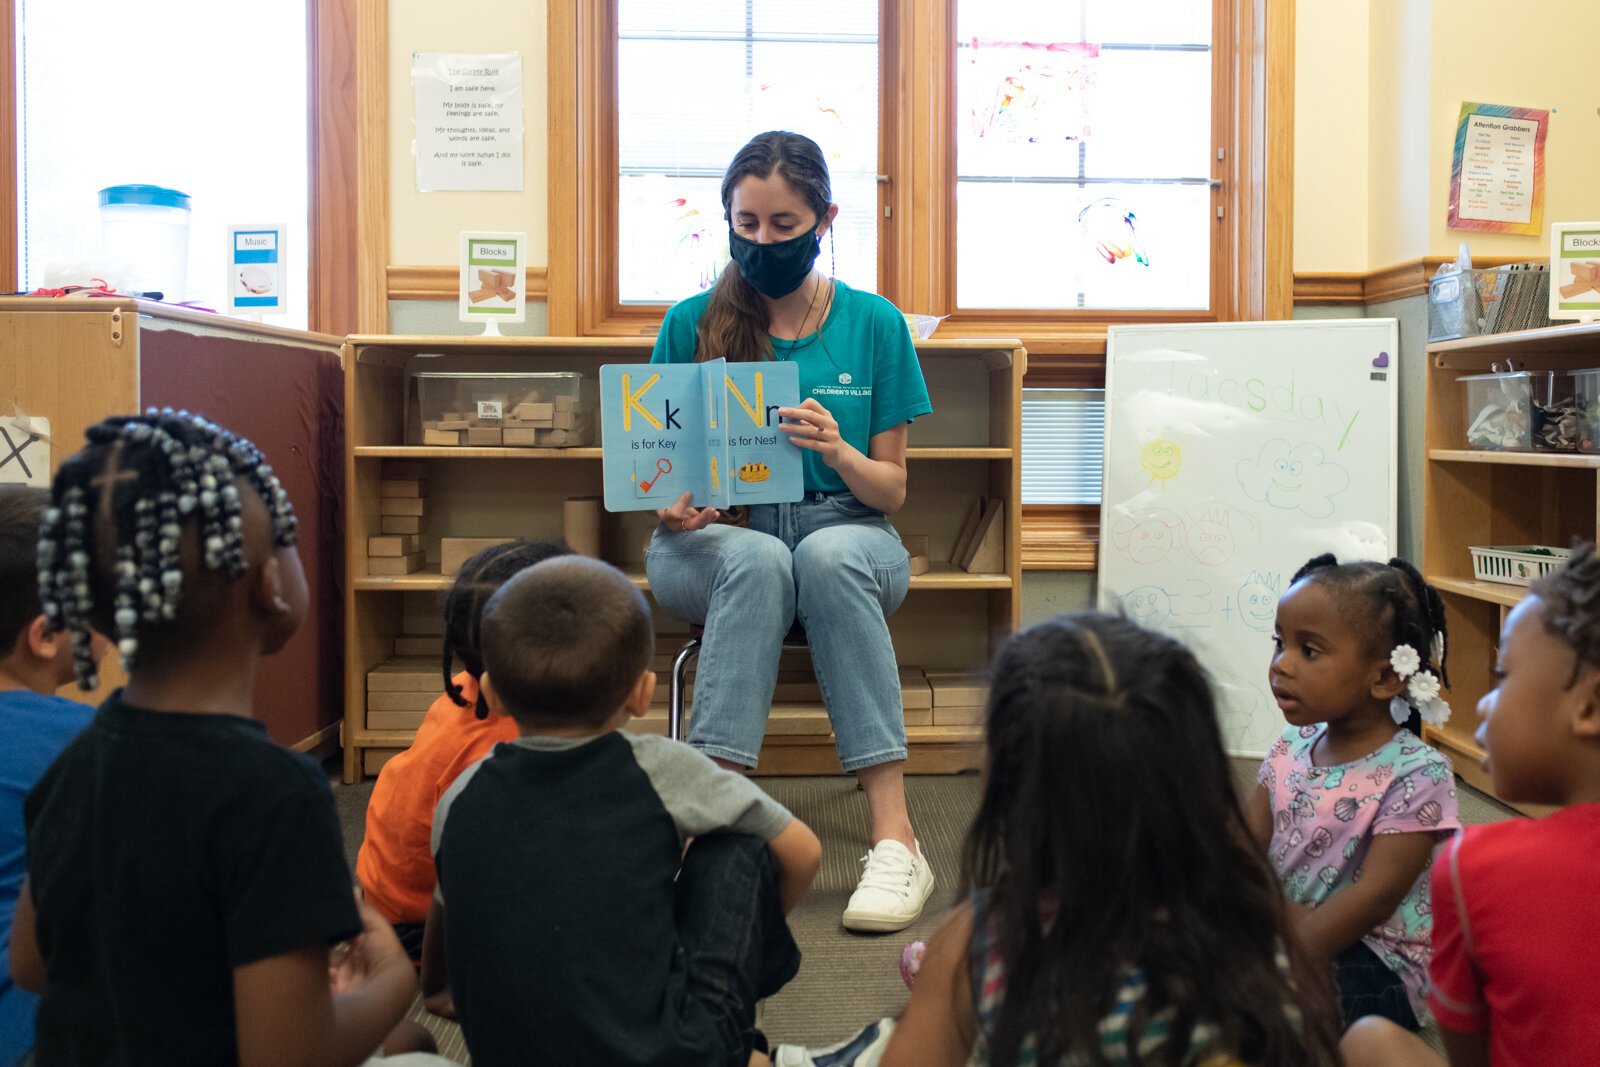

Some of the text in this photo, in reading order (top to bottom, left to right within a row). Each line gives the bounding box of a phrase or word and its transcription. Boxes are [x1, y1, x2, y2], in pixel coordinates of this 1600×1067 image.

[1474, 121, 1531, 133] Attention Grabbers
[244, 238, 268, 246] Music
[1572, 238, 1600, 247] Block
[480, 247, 507, 256] Blocks
[1170, 349, 1360, 451] Tuesday
[631, 438, 677, 451] is for Key
[728, 437, 738, 446] is
[739, 436, 752, 446] for
[755, 434, 778, 446] Nest
